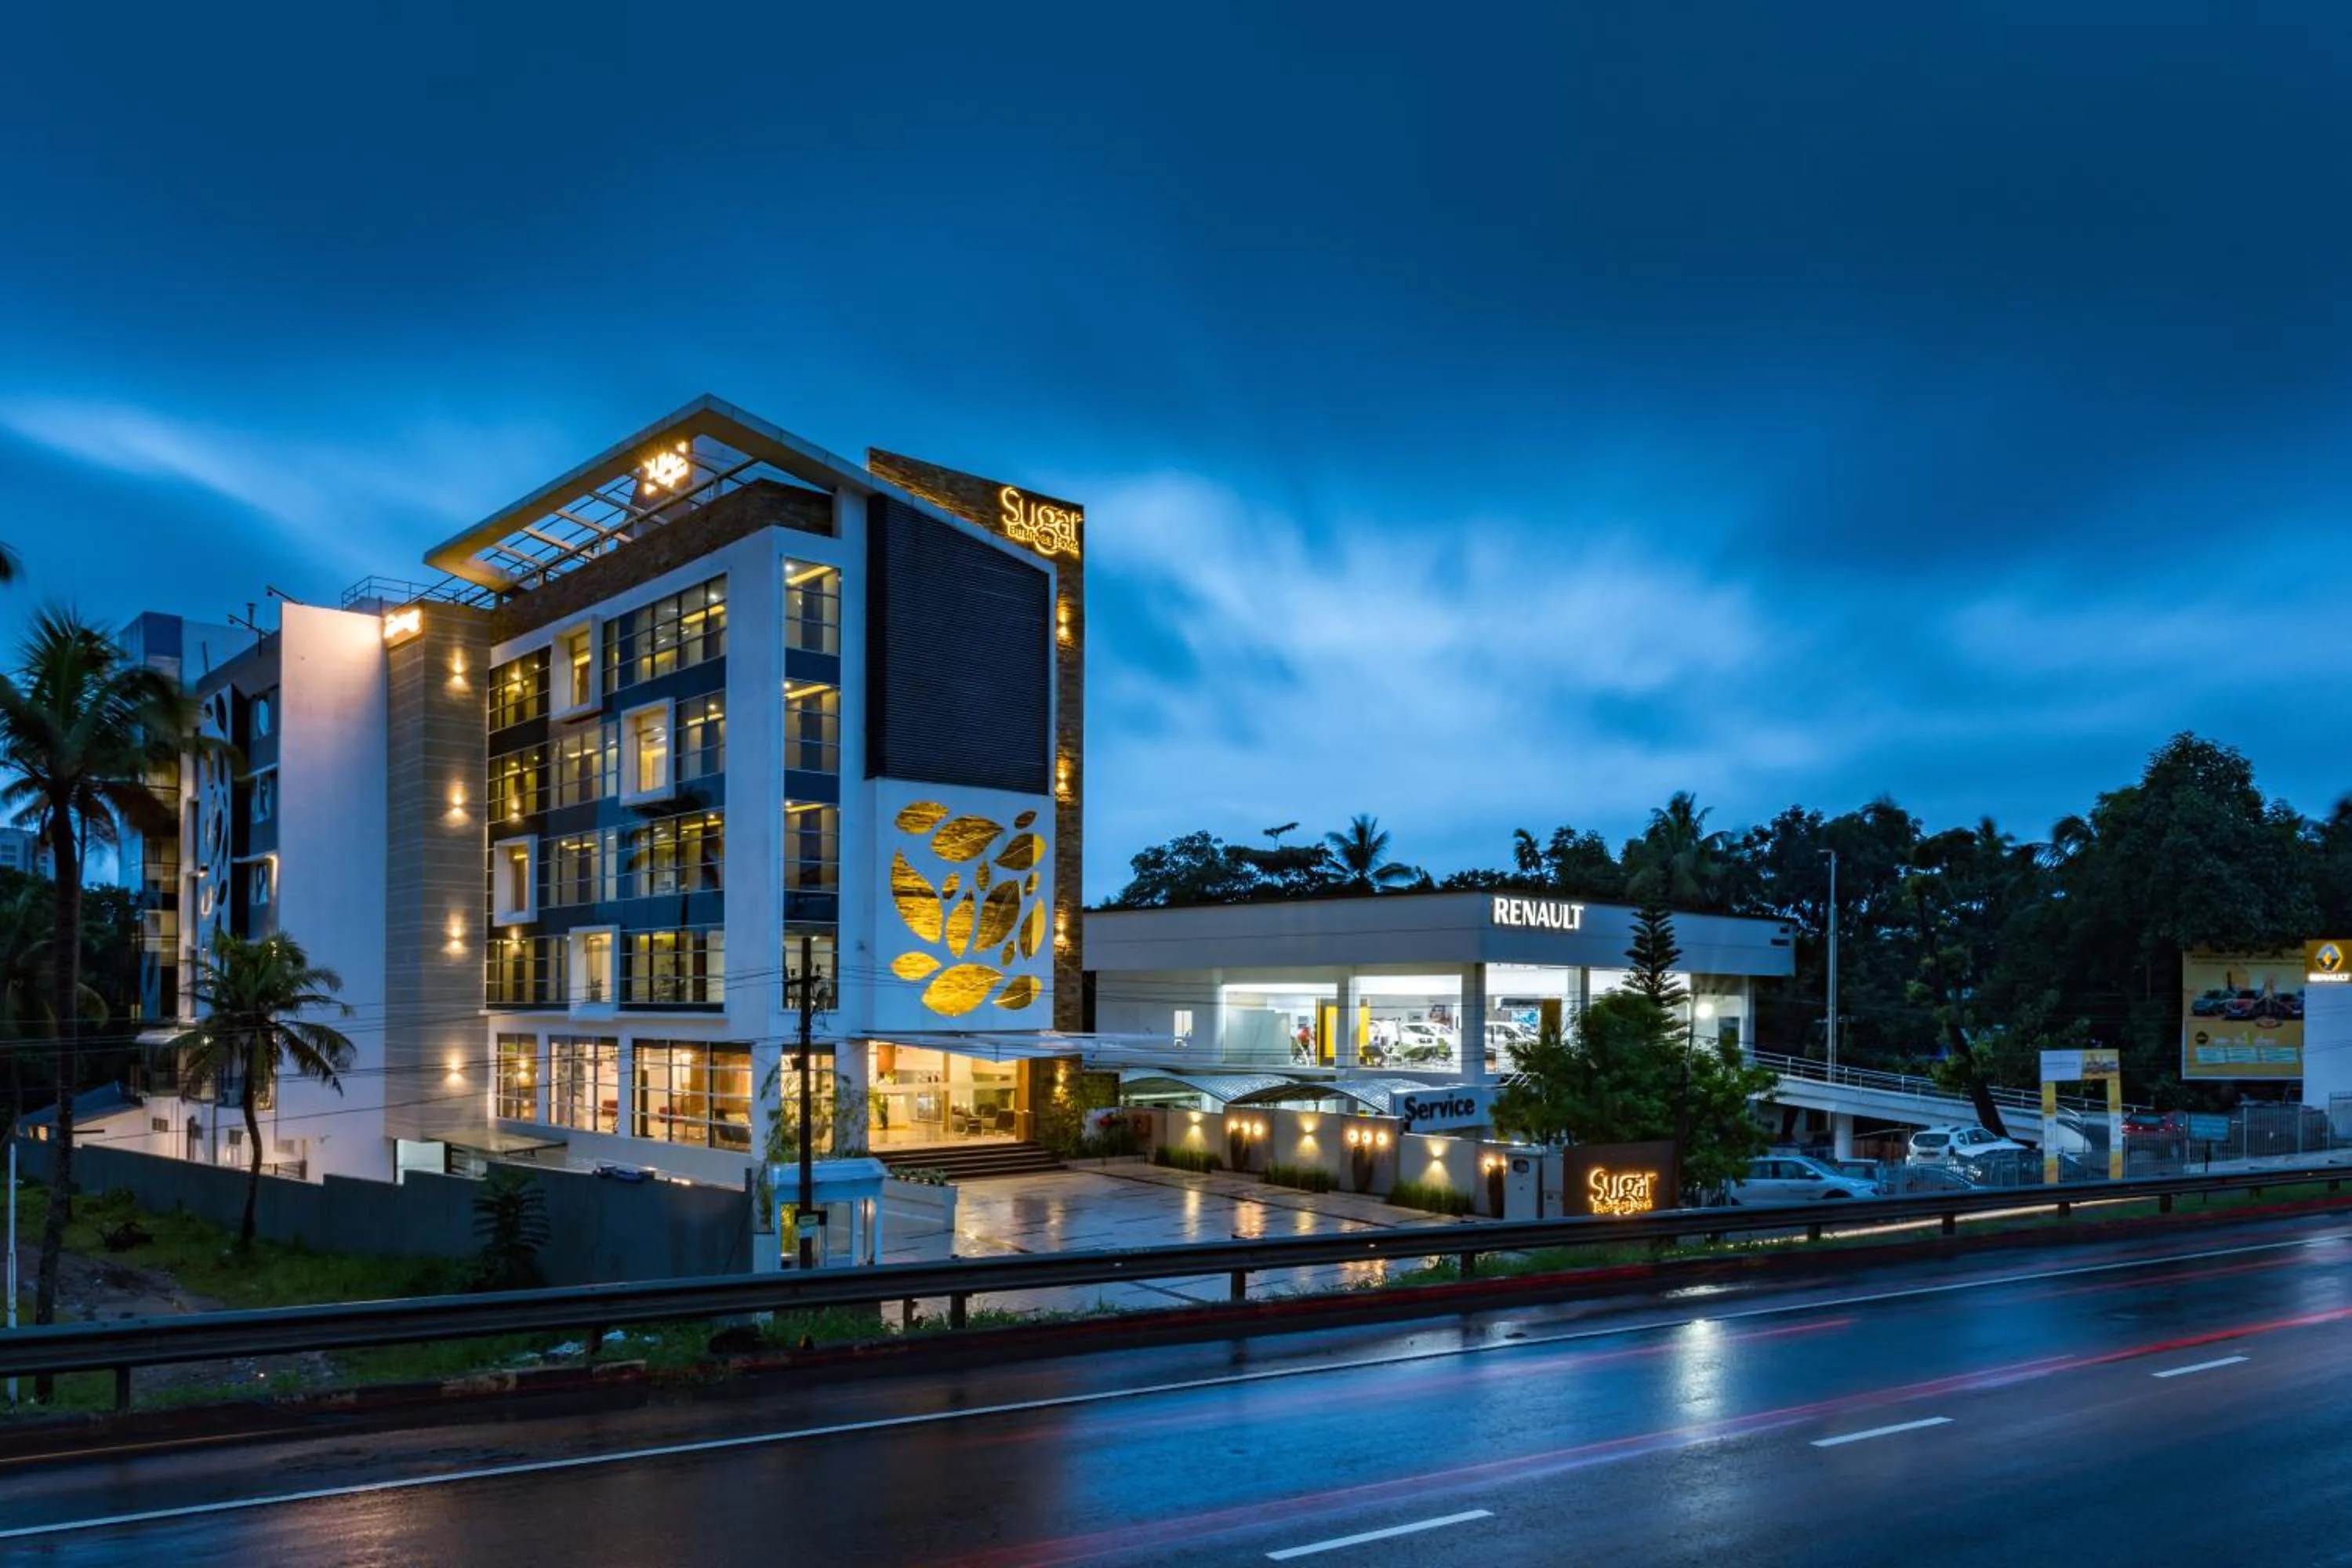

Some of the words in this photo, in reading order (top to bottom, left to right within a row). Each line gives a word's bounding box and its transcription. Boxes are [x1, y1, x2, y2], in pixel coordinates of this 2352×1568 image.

[1000, 486, 1084, 554] Sugar
[1494, 897, 1584, 929] RENAULT
[1404, 1093, 1475, 1121] Service
[1589, 1167, 1657, 1214] Sugar
